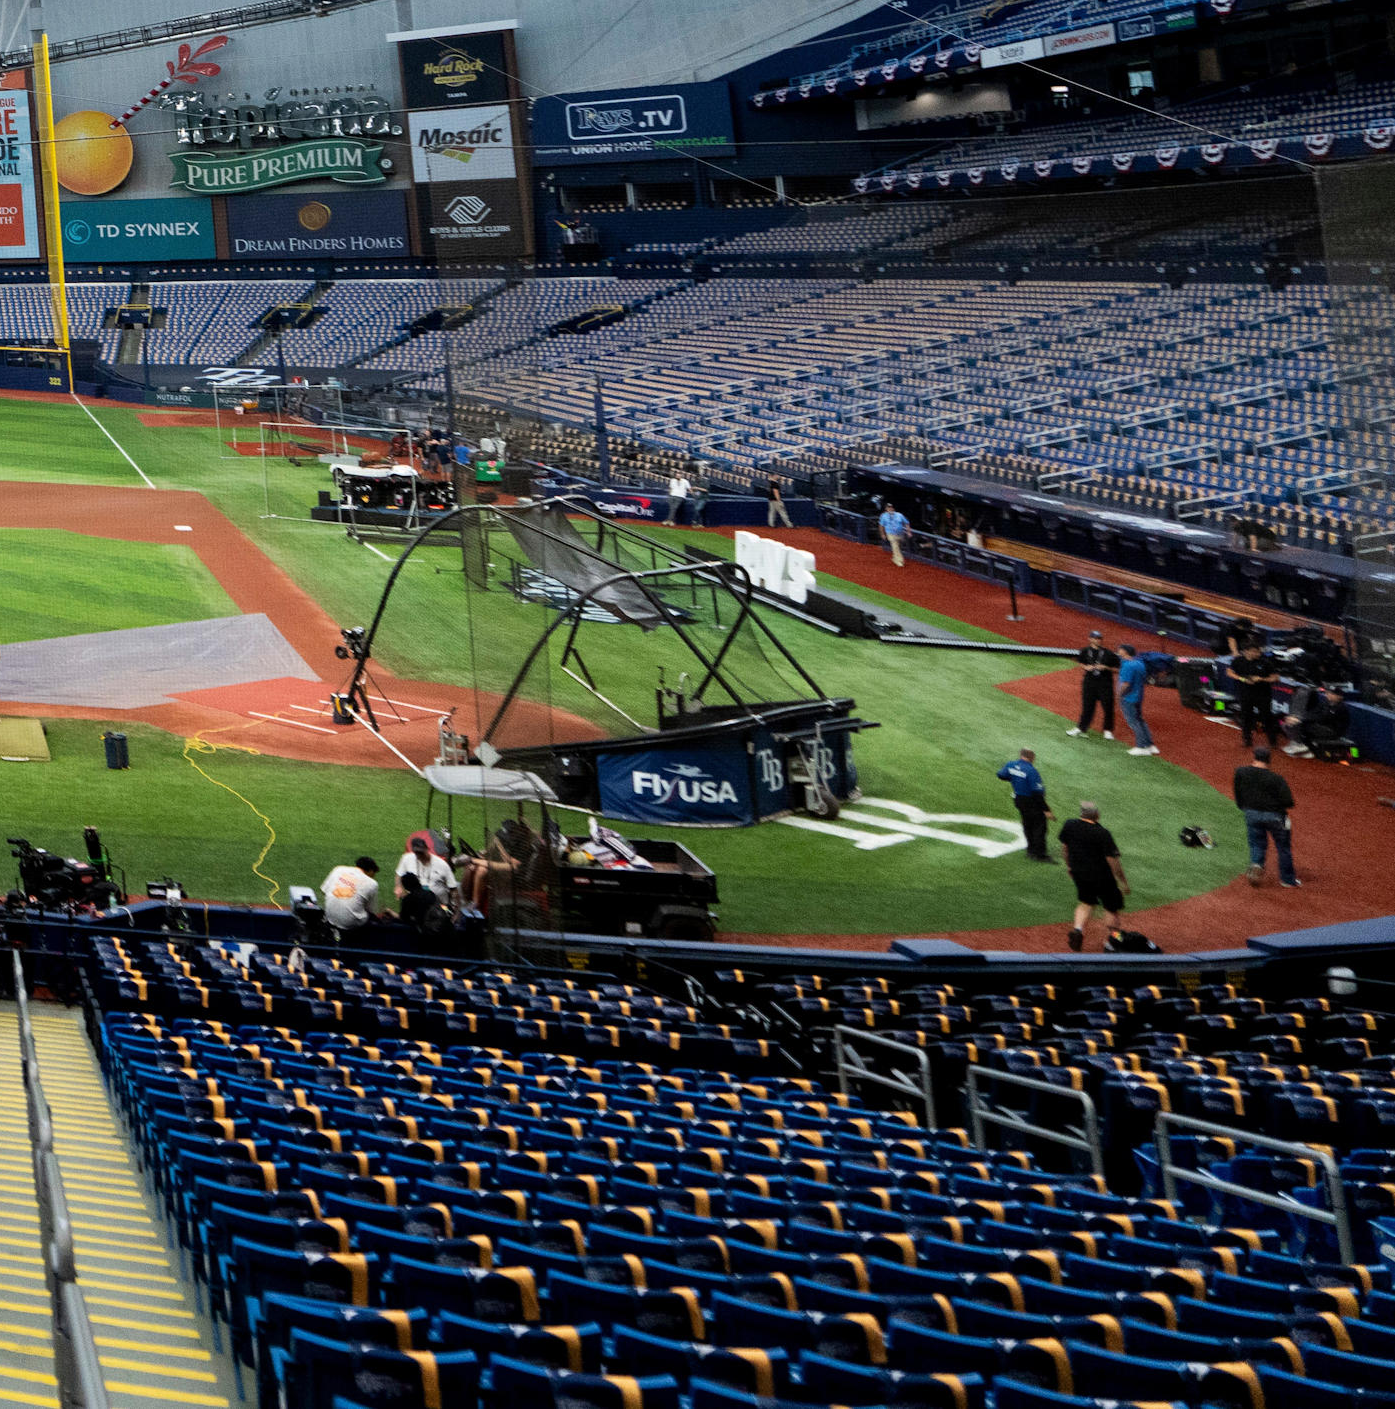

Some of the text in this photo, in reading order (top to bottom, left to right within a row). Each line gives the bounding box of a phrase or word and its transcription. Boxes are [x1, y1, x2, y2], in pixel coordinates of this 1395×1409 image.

[418, 122, 503, 147] Mosaic
[571, 144, 613, 155] UNION
[614, 140, 653, 152] HOME
[187, 147, 363, 187] PURE PREMIUM
[96, 222, 200, 238] TD SYNNEX
[234, 236, 404, 253] DREAM FINDERS HOMES
